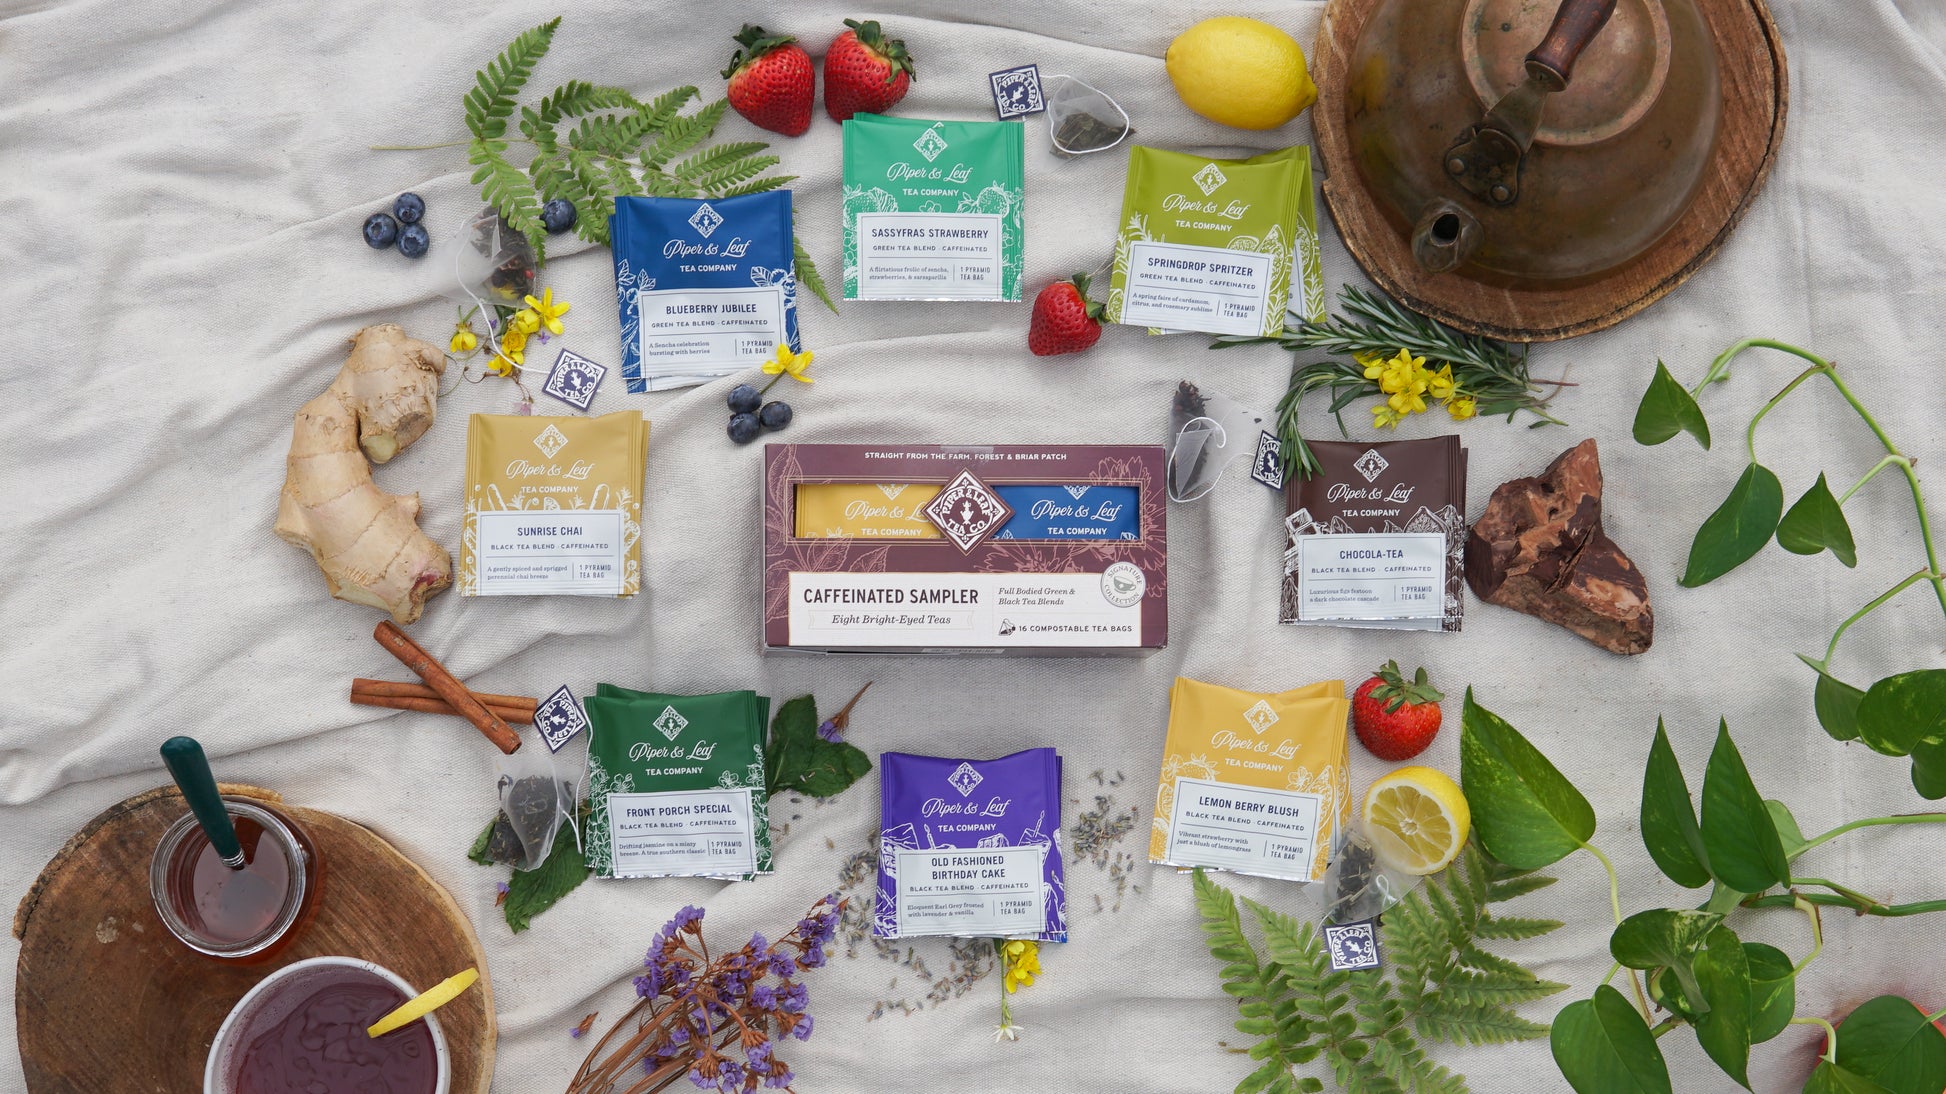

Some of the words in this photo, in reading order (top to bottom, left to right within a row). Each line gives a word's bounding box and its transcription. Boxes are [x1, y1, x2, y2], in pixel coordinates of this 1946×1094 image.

[887, 162, 926, 181] Piper
[928, 168, 942, 179] &
[943, 163, 973, 183] Leaf
[1162, 194, 1201, 212] Piper
[1203, 202, 1217, 212] &
[1217, 200, 1251, 220] Leaf
[872, 229, 925, 237] SASSYFRAS
[929, 229, 988, 238] STRAWBERRY
[1193, 222, 1232, 231] COMPANY
[663, 239, 702, 259] Piper
[705, 242, 718, 256] &
[720, 237, 751, 258] Leaf
[698, 264, 737, 272] COMPANY
[1148, 258, 1206, 271] SPRINGDROP
[1209, 264, 1253, 276] SPRITZER
[1209, 280, 1256, 290] CAFFEINATED
[666, 305, 718, 314] BLUEBERRY
[722, 304, 756, 313] JUBILEE
[506, 460, 545, 479] Piper
[548, 466, 560, 475] &
[562, 460, 595, 480] Leaf
[1327, 483, 1366, 502] Piper
[1369, 489, 1383, 499] &
[1384, 483, 1415, 503] Leaf
[942, 489, 965, 514] PIPER
[966, 489, 972, 498] &
[845, 500, 887, 520] Piper
[889, 506, 903, 518] &
[905, 501, 931, 522] Le
[1031, 500, 1073, 520] Piper
[1075, 505, 1089, 517] &
[1091, 501, 1122, 521] Leaf
[518, 527, 557, 536] SUNRISE
[561, 527, 582, 535] CHAI
[949, 519, 965, 534] TEA
[1066, 527, 1107, 535] COMPANY
[1340, 550, 1403, 559] CHOCOLA-TEA
[1108, 566, 1142, 584] SIGNATURE
[804, 588, 904, 603] CAFFEINATED
[910, 589, 978, 603] SAMPLER
[1105, 585, 1139, 604] COLLECTION
[832, 615, 861, 625] Eight
[862, 614, 924, 625] Bright-Eyed
[927, 615, 951, 624] Teas
[629, 742, 668, 761] Piper
[670, 746, 684, 758] &
[686, 740, 717, 760] Leaf
[1211, 730, 1252, 751] Piper
[1254, 741, 1268, 752] &
[1269, 739, 1302, 759] Leaf
[664, 767, 703, 775] COMPANY
[1225, 758, 1240, 766] TEA
[1243, 761, 1283, 772] COMPANY
[627, 808, 656, 817] FRONT
[659, 806, 690, 817] PORCH
[694, 805, 732, 814] SPECIAL
[922, 798, 961, 817] Piper
[964, 802, 978, 814] &
[980, 796, 1011, 817] Leaf
[1199, 796, 1231, 809] LEMON
[1235, 801, 1265, 813] BERRY
[1268, 805, 1299, 817] BLUSH
[1186, 811, 1209, 819] BLACK
[1257, 820, 1304, 831] CAFFEINATED
[932, 857, 948, 867] OLD
[952, 856, 1004, 866] FASHIONED
[932, 870, 978, 879] BIRTHDAY
[982, 869, 1005, 878] CAKE
